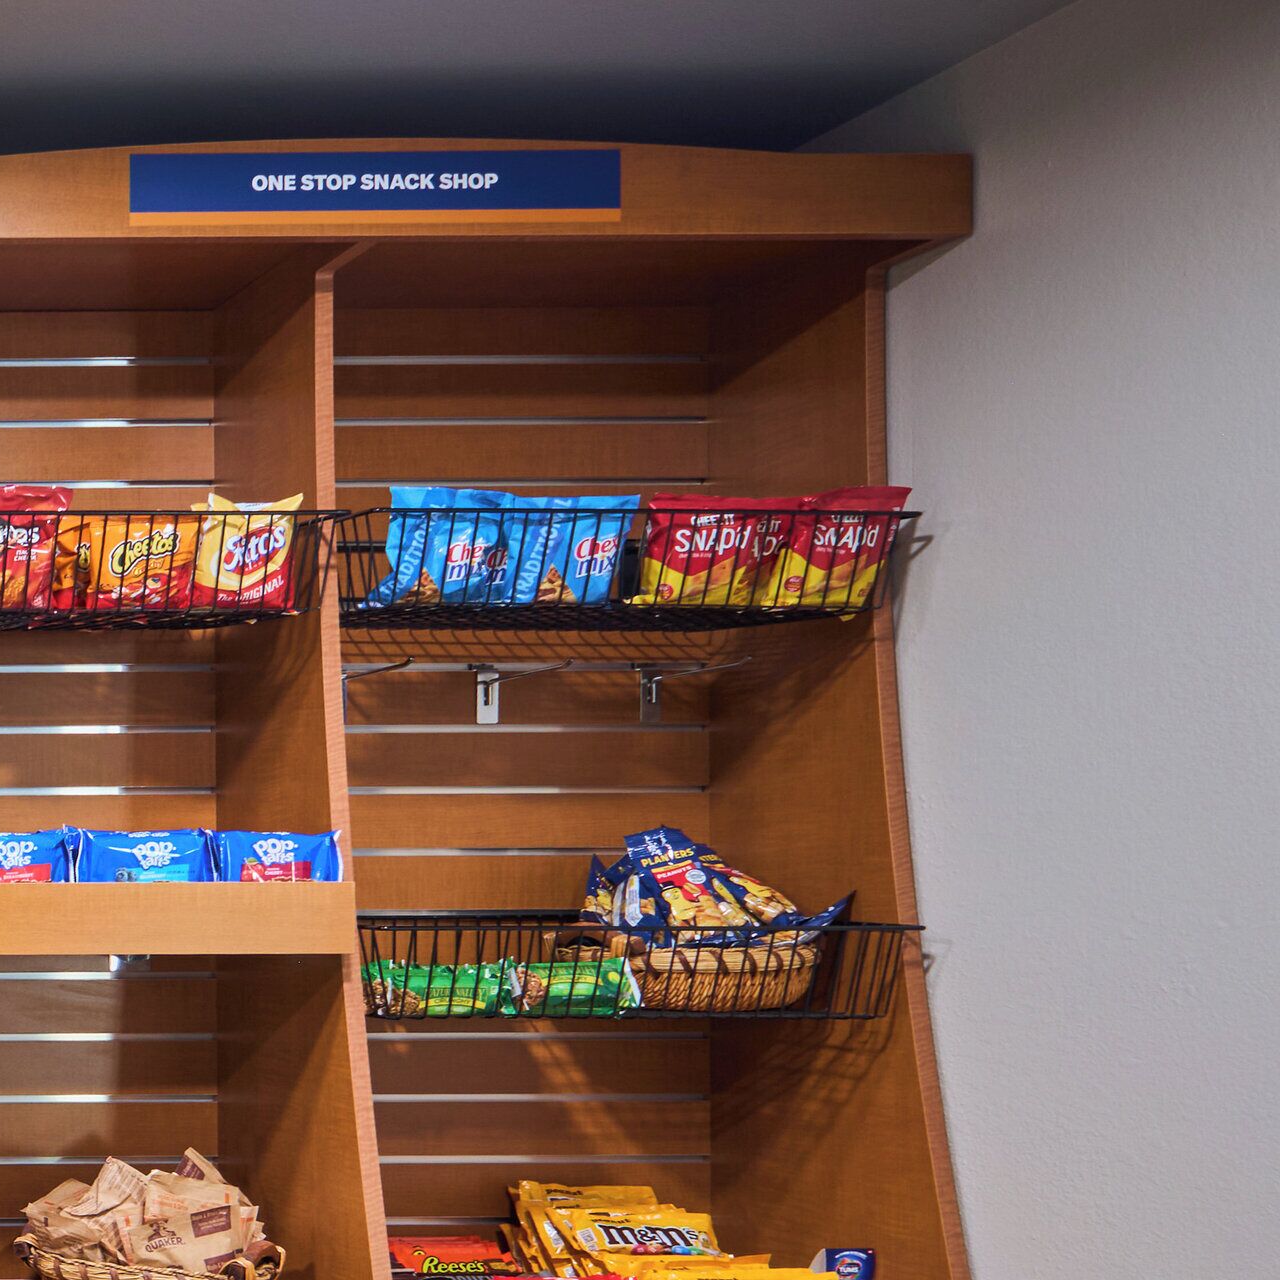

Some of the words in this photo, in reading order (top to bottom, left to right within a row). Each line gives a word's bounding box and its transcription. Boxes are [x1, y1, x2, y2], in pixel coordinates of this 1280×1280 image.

[252, 174, 296, 192] ONE
[301, 174, 356, 191] STOP
[360, 173, 434, 191] SNACK
[439, 173, 498, 190] SHOP
[109, 531, 180, 575] Cheetos
[144, 1236, 184, 1254] QUAKER
[596, 1223, 700, 1248] m&m's
[421, 1255, 485, 1274] Reese's
[838, 1265, 859, 1274] TUMS
